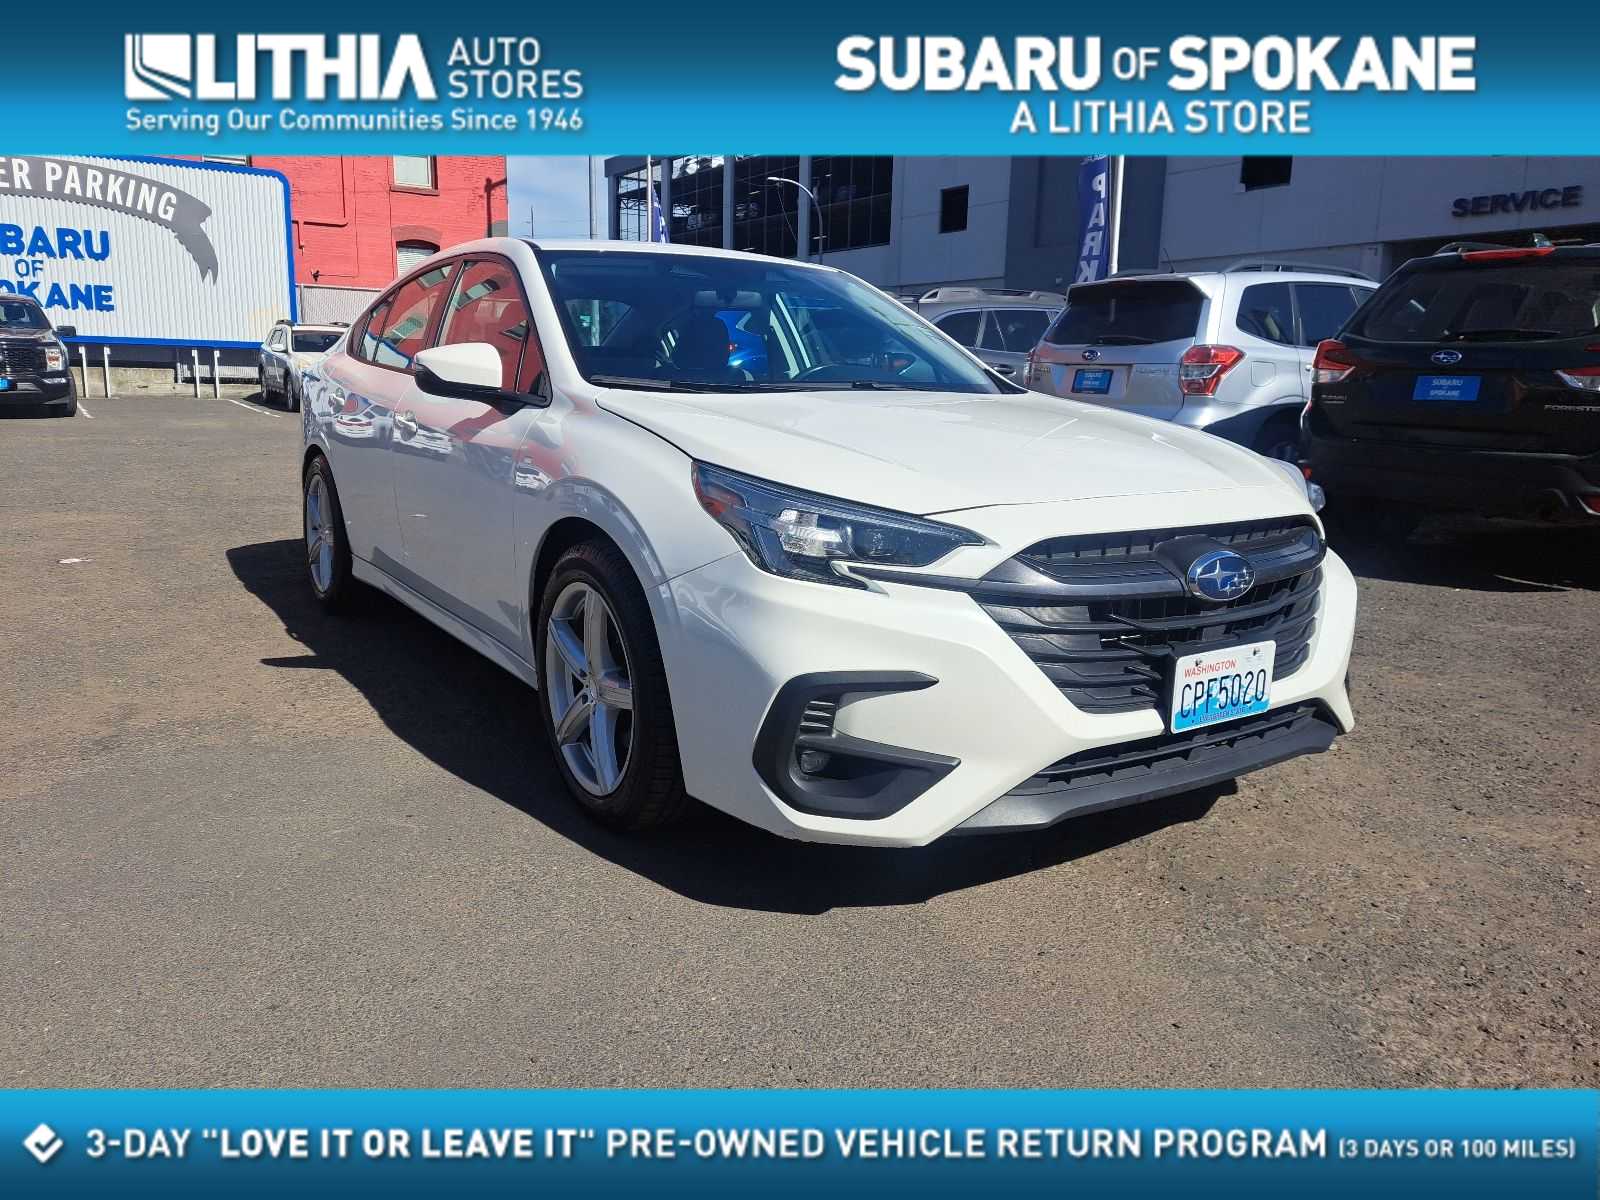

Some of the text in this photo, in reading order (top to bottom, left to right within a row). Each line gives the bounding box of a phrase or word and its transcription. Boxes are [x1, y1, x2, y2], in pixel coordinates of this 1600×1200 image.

[45, 161, 177, 221] PARKING
[1451, 185, 1583, 217] SERVICE
[0, 224, 110, 261] BARU
[15, 259, 44, 278] OF
[1185, 660, 1236, 677] WASHINGTON
[1181, 669, 1265, 718] CPF5020
